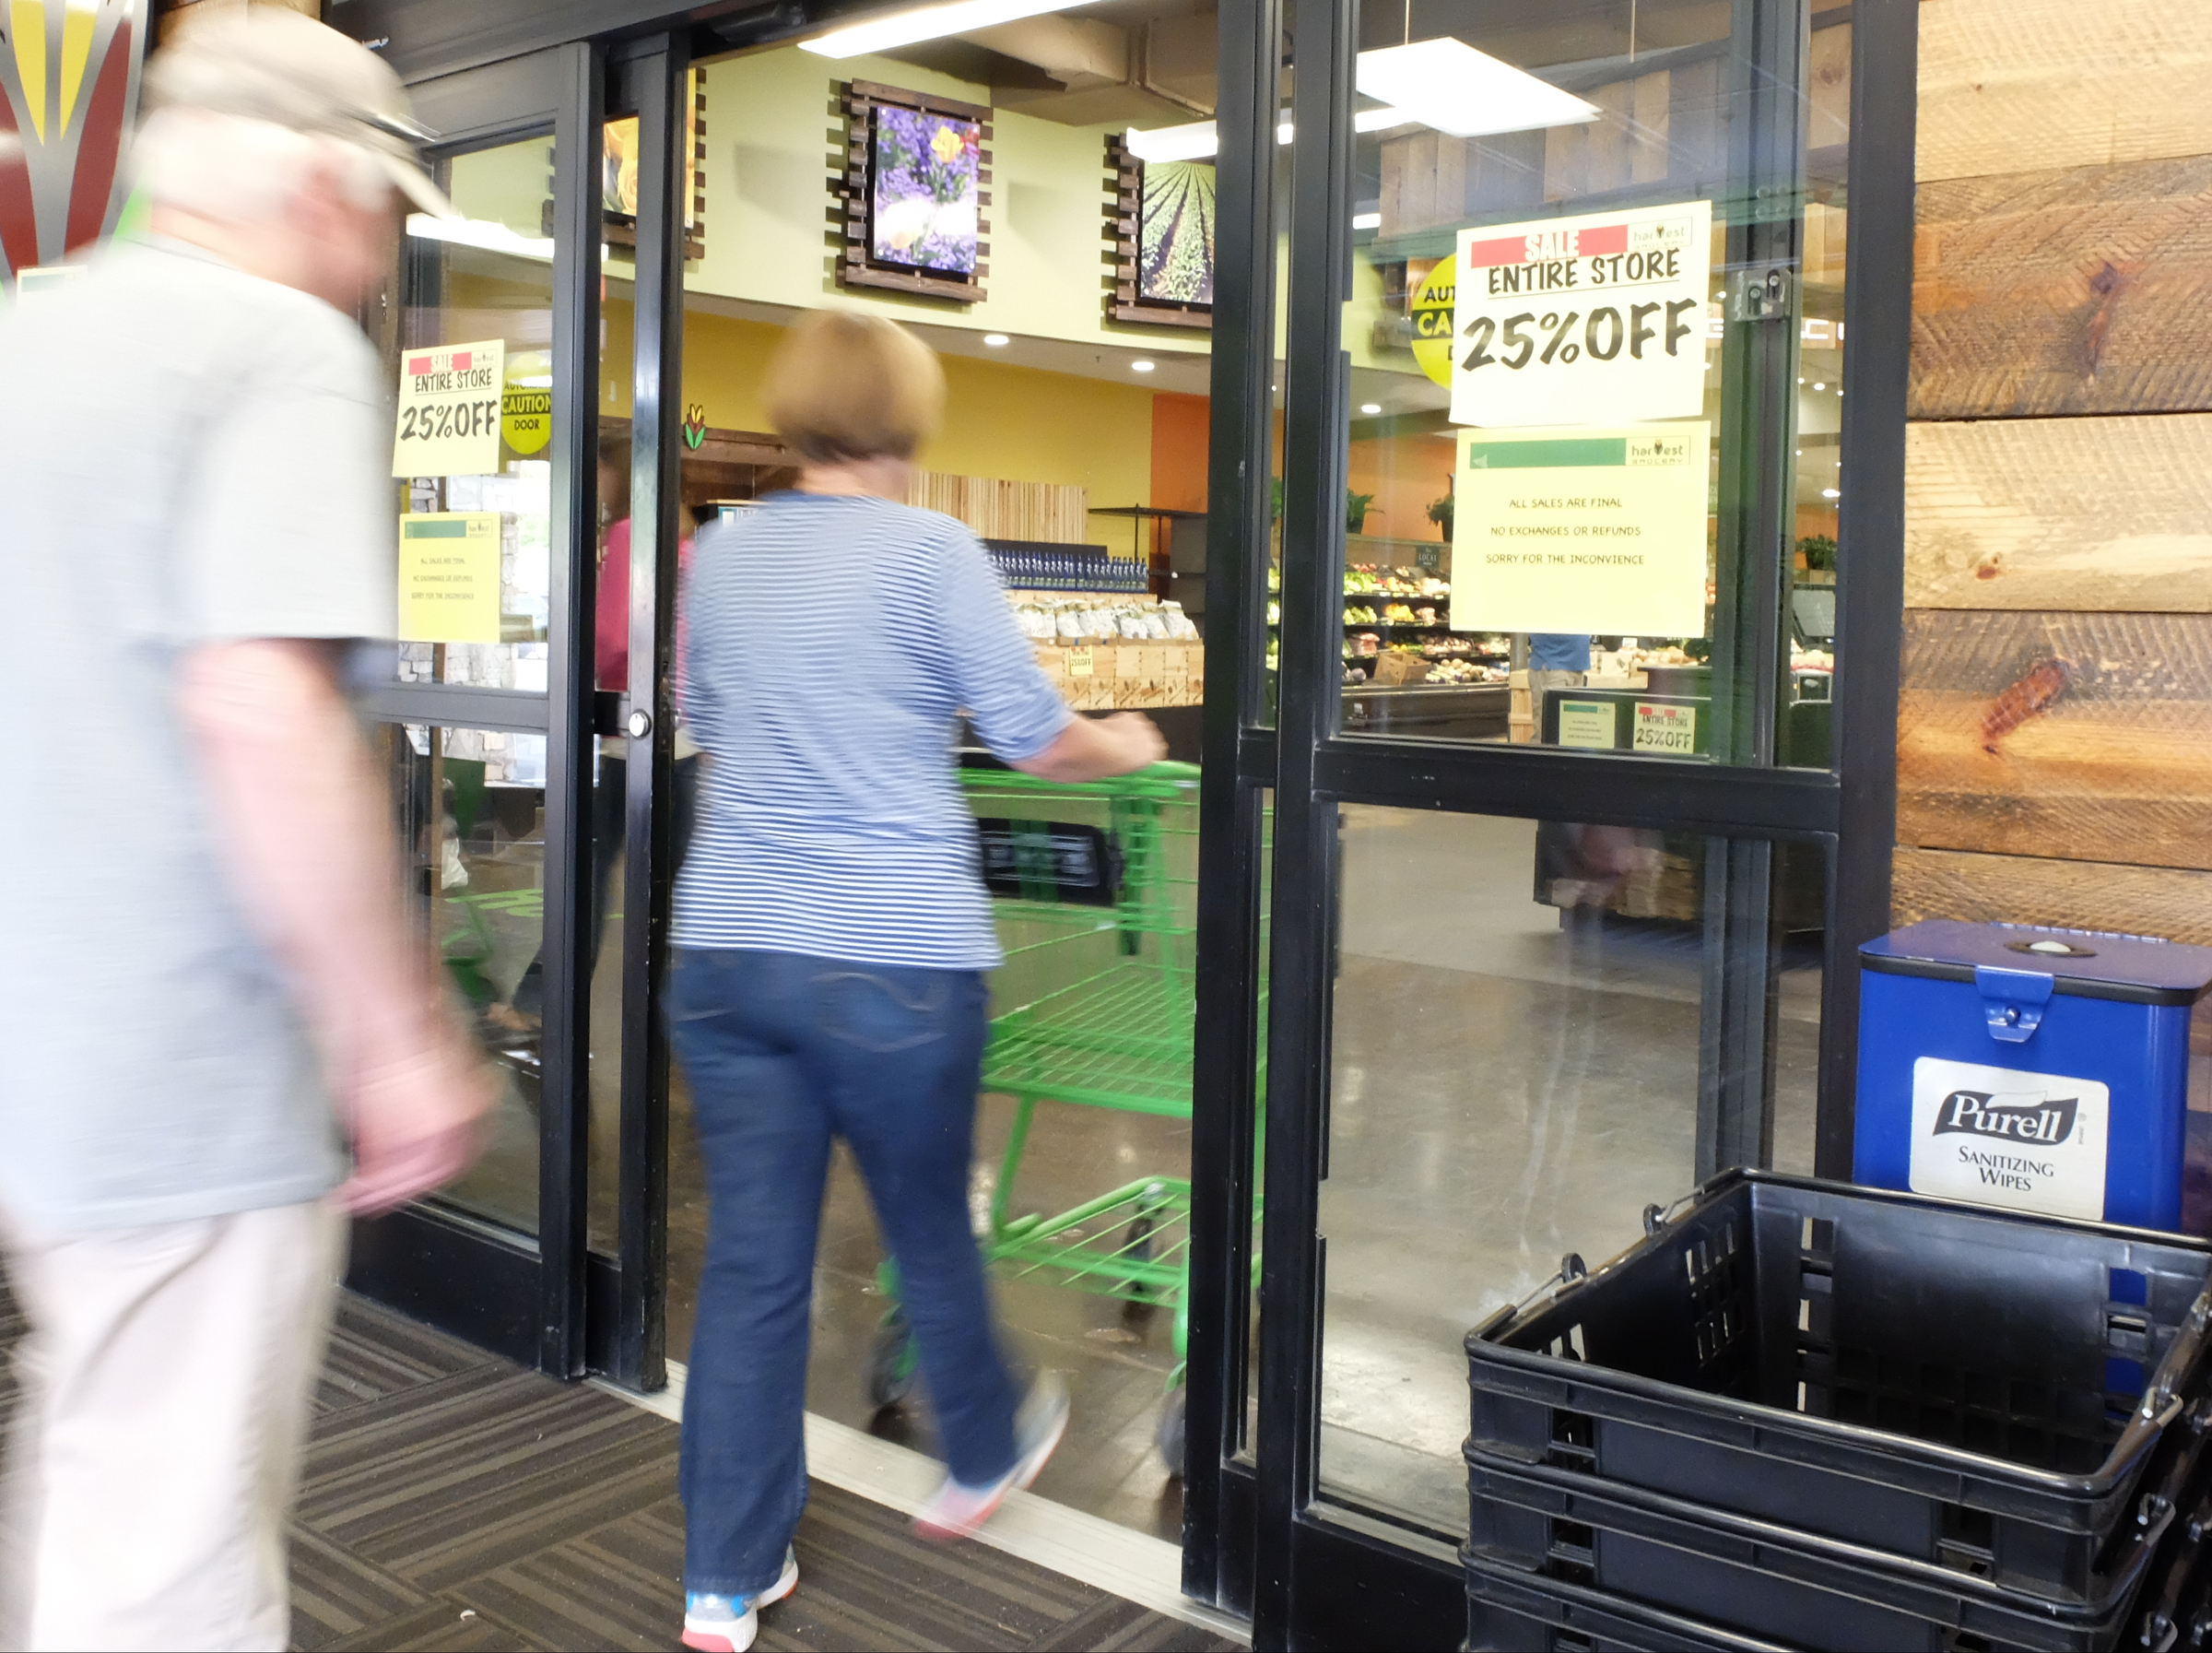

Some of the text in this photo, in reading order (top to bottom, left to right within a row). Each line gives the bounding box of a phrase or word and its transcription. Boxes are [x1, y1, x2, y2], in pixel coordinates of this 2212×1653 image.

[1524, 230, 1580, 262] SALE
[1488, 247, 1681, 295] ENTIRE STORE
[430, 353, 454, 373] SALE
[415, 372, 453, 393] ENTIRE
[457, 368, 492, 389] STORE
[501, 395, 551, 414] CAUTION
[514, 419, 539, 431] DOOR
[1509, 498, 1622, 508] ALL SALES ARE FINAL
[1490, 526, 1641, 537] NO EXCHANGES OR REFUNDS
[1486, 554, 1644, 564] SORRY FOR THE INCONVIENCE
[1947, 1093, 2062, 1143] Purell
